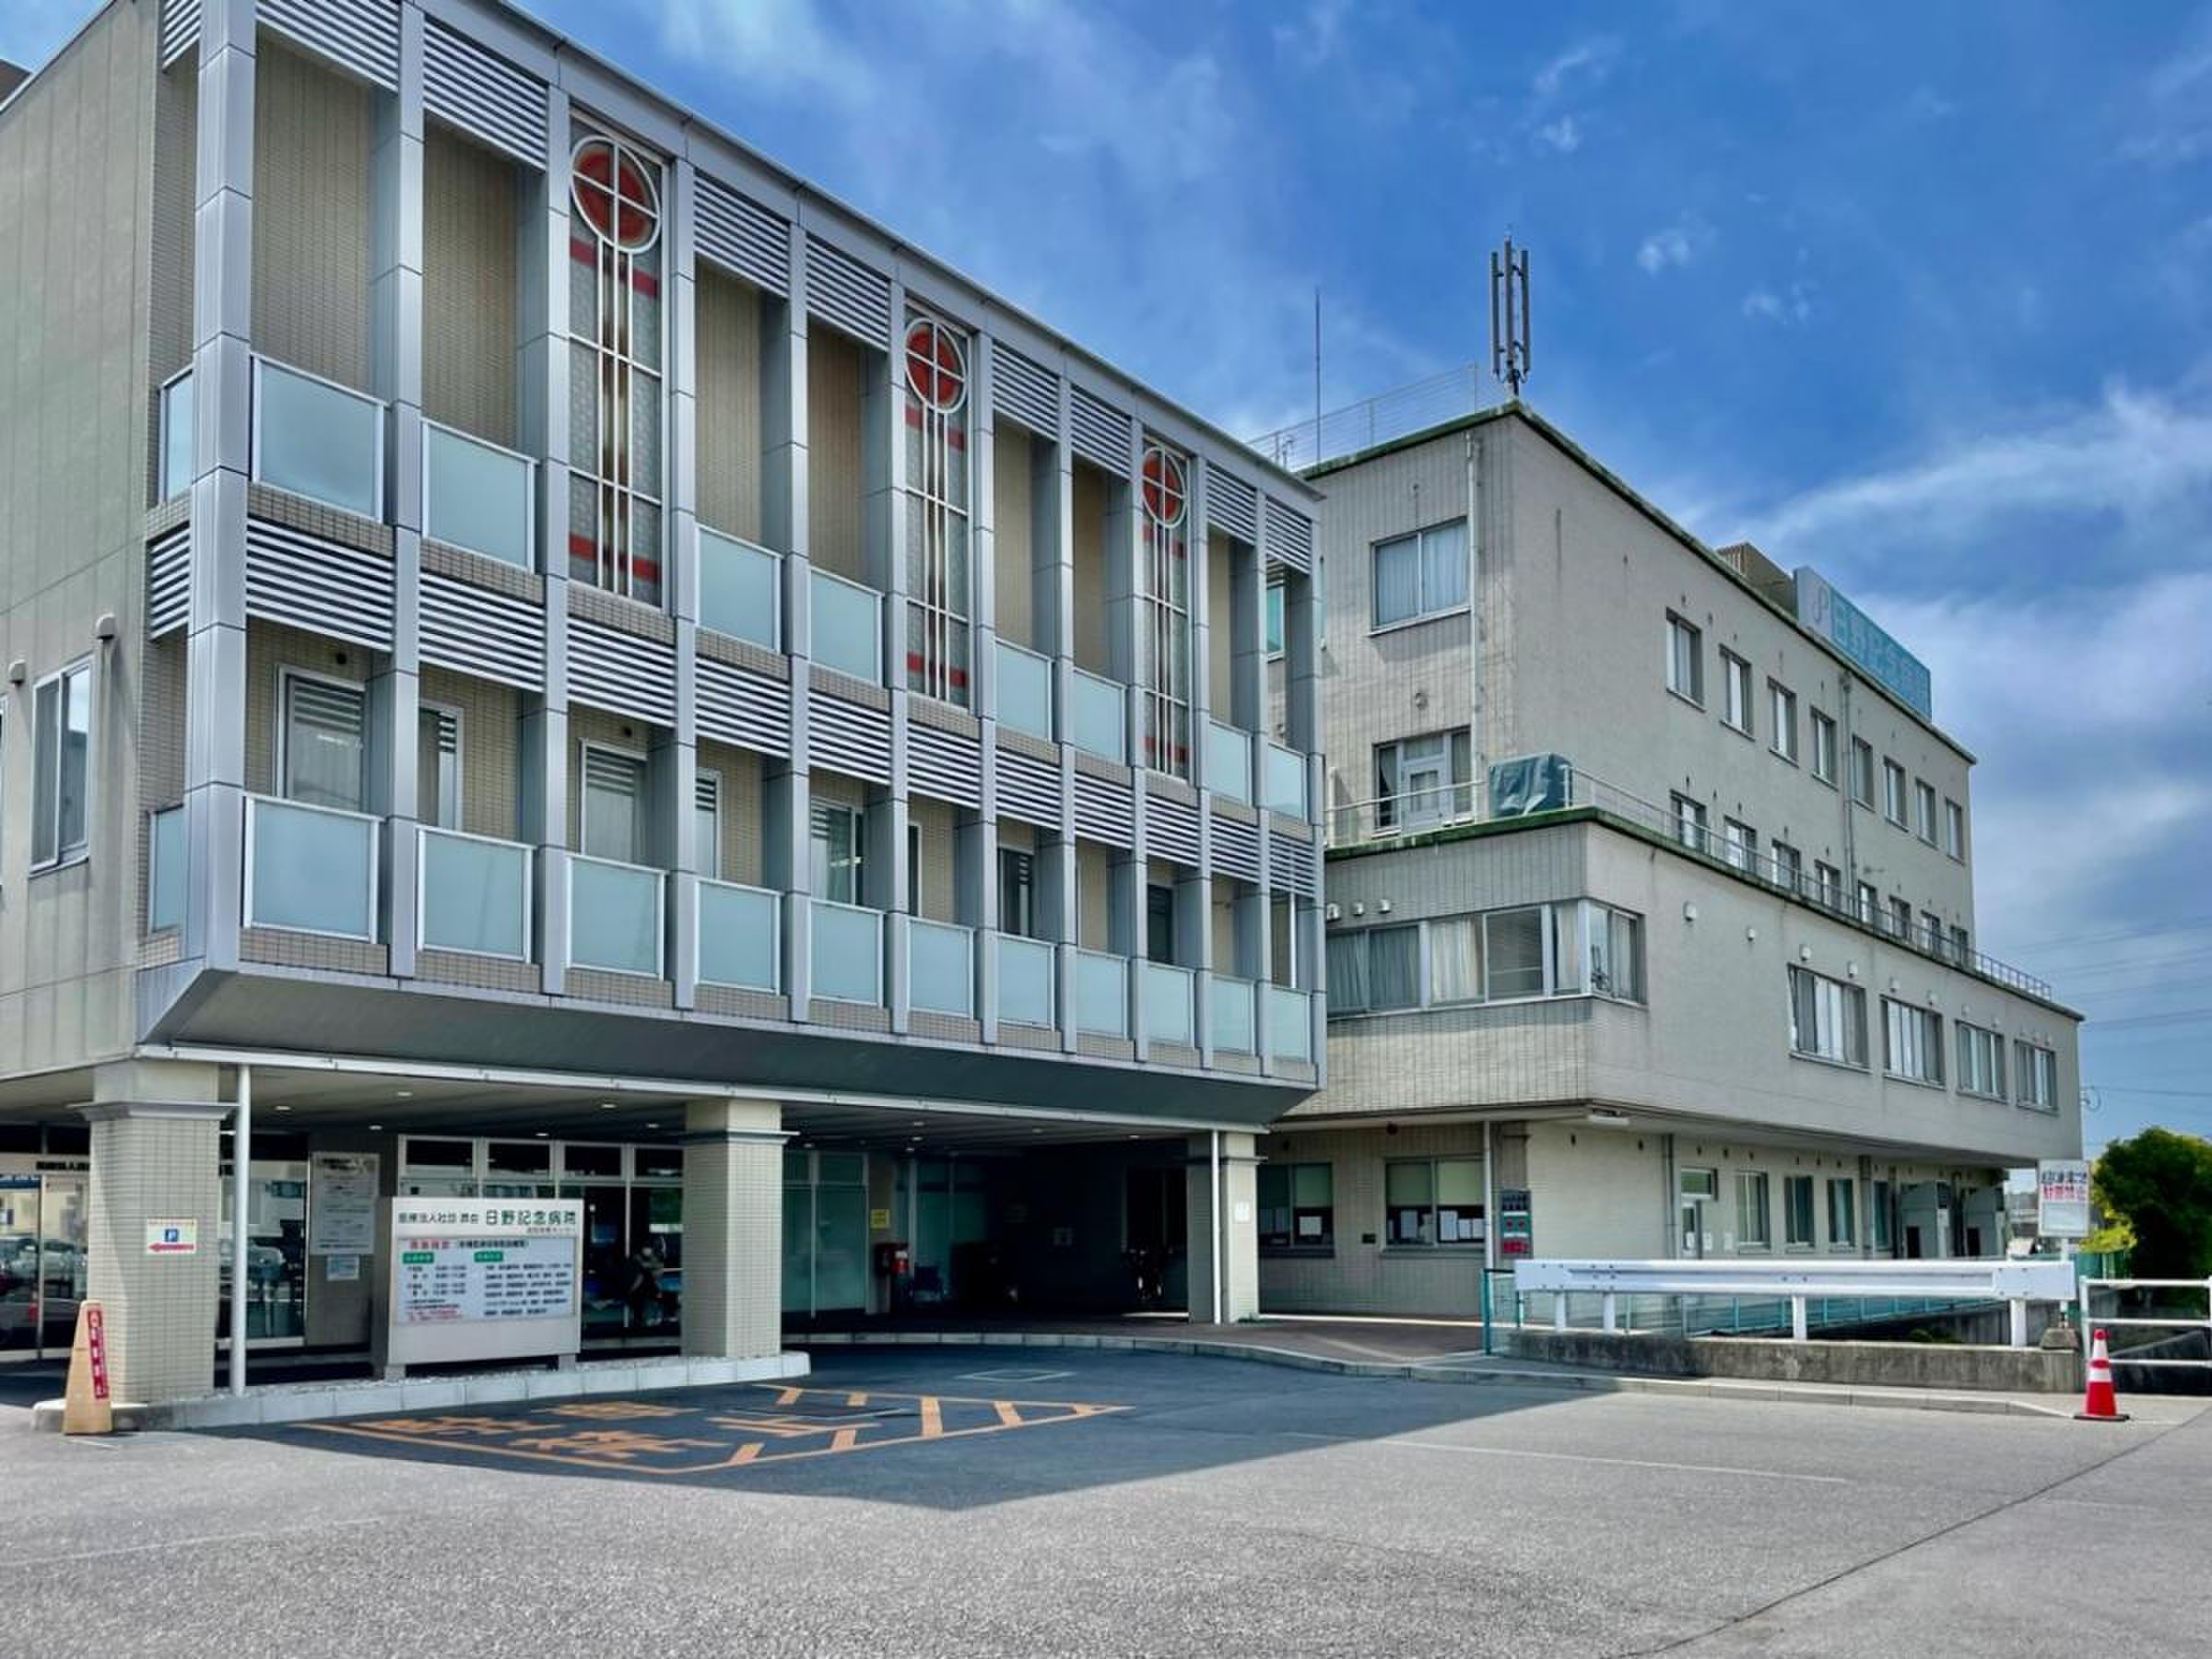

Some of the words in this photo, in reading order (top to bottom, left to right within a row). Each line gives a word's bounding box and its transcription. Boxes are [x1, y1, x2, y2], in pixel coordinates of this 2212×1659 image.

[486, 1209, 575, 1225] 日野記念病院
